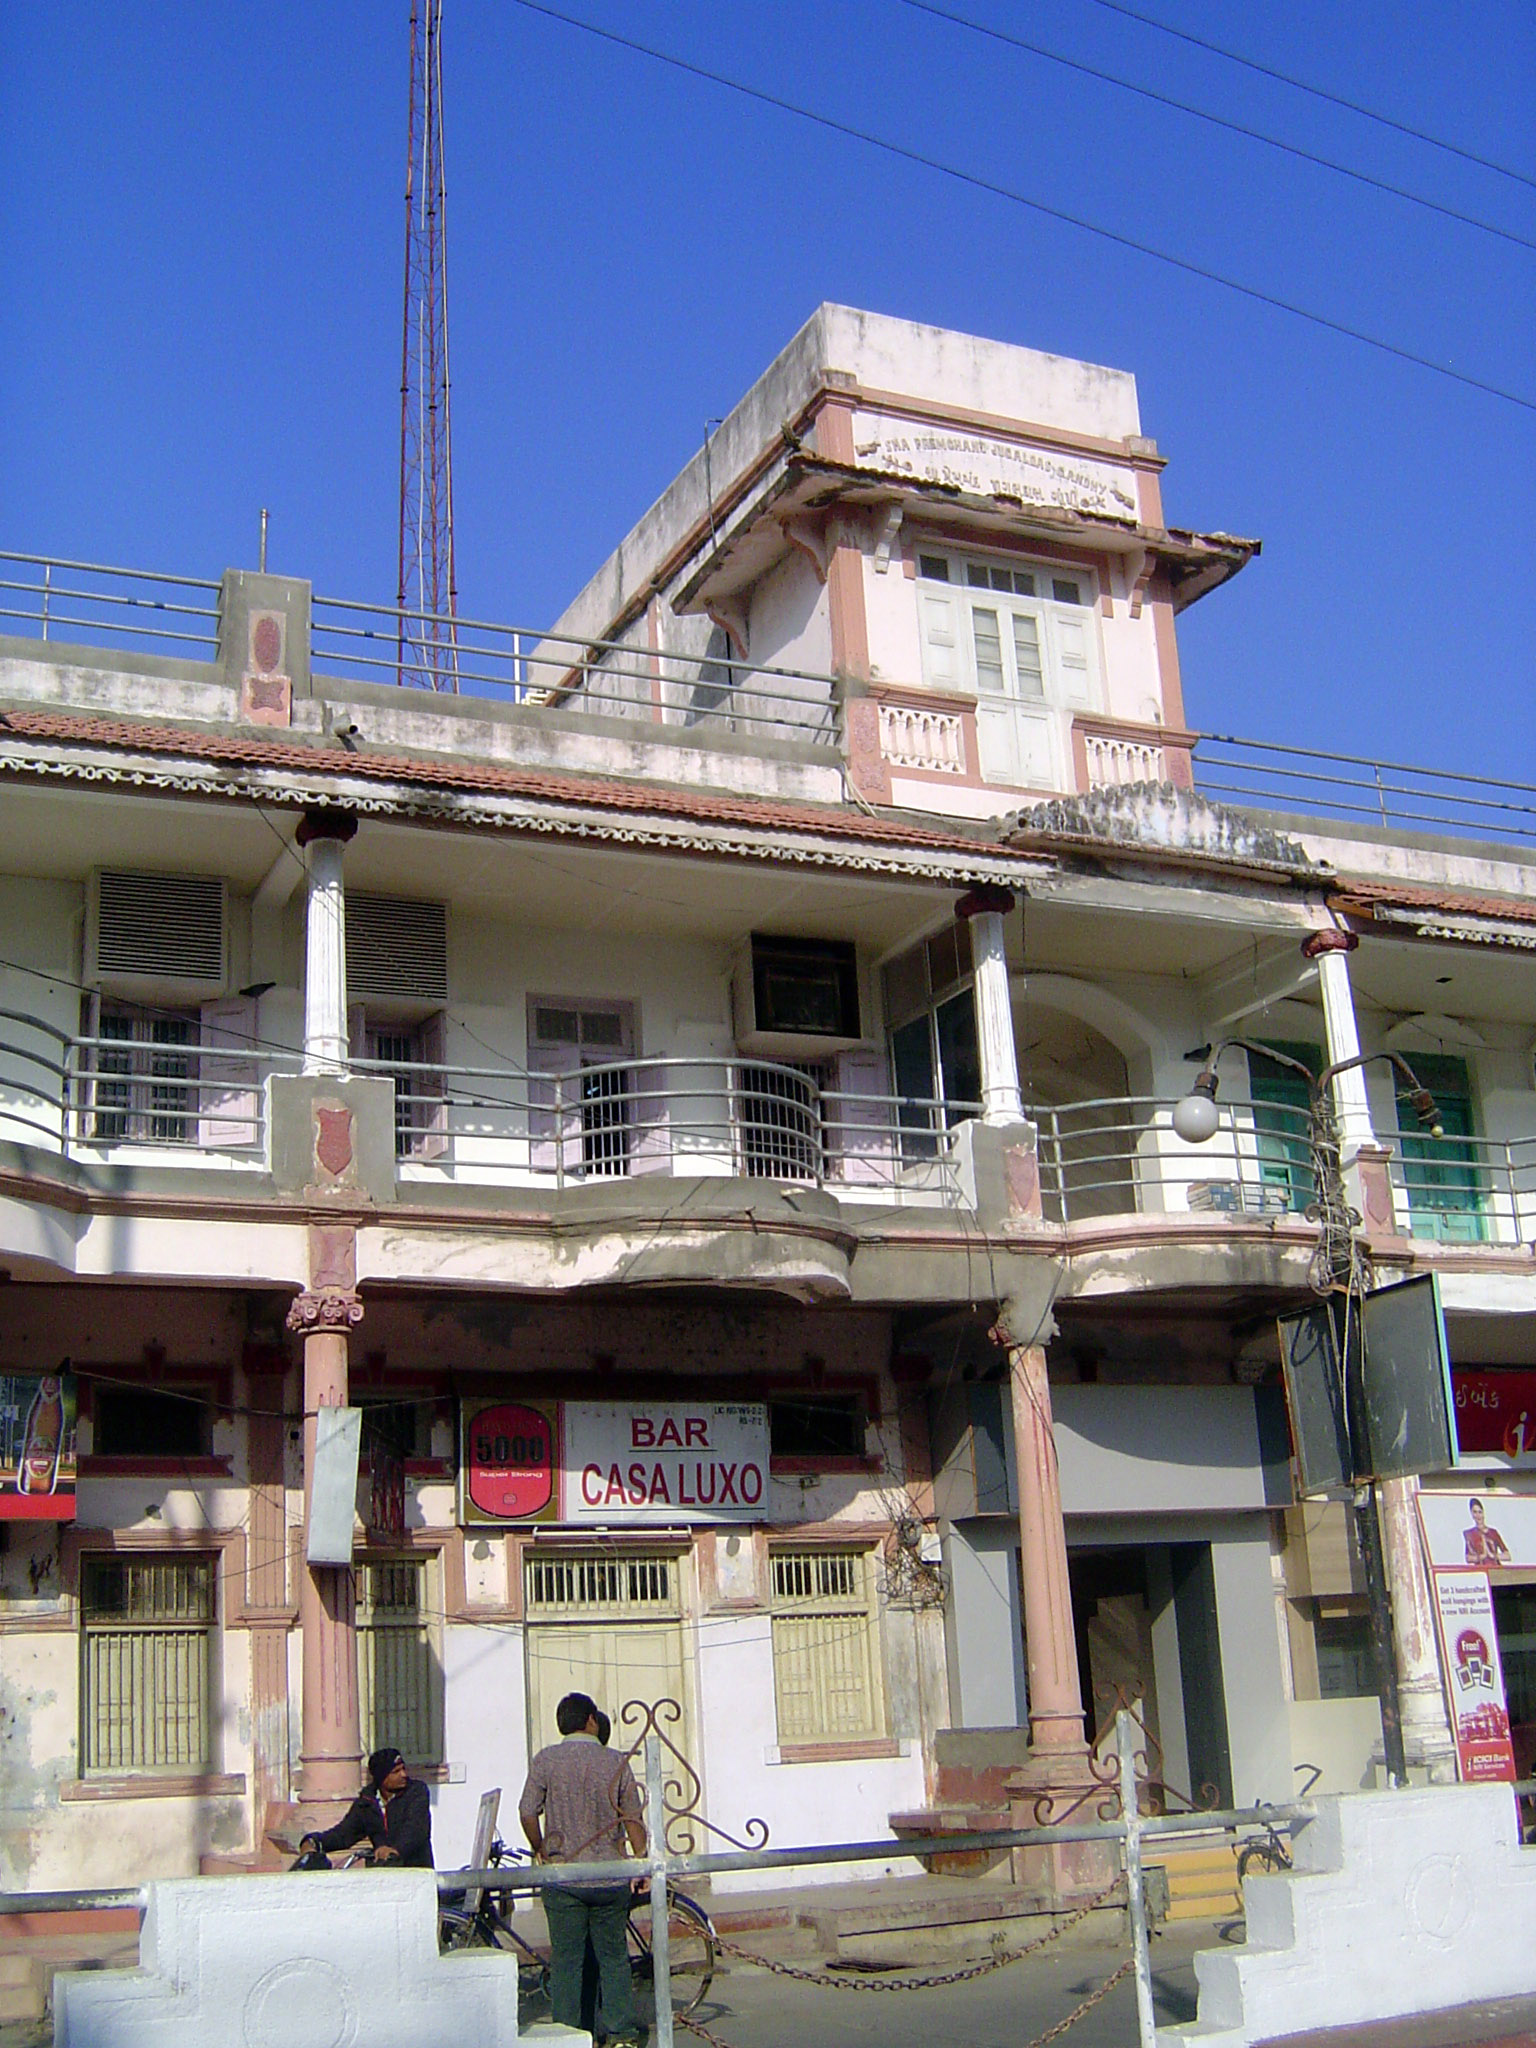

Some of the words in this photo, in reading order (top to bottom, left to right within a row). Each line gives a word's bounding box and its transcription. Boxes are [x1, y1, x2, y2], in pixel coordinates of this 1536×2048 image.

[631, 1418, 709, 1447] BAR
[476, 1435, 545, 1463] 5000
[479, 1471, 508, 1479] Super
[511, 1470, 543, 1479] Strong
[581, 1463, 671, 1506] CASA
[679, 1463, 763, 1506] LUXO
[1473, 1754, 1492, 1763] ICICI
[1493, 1753, 1510, 1762] Bank
